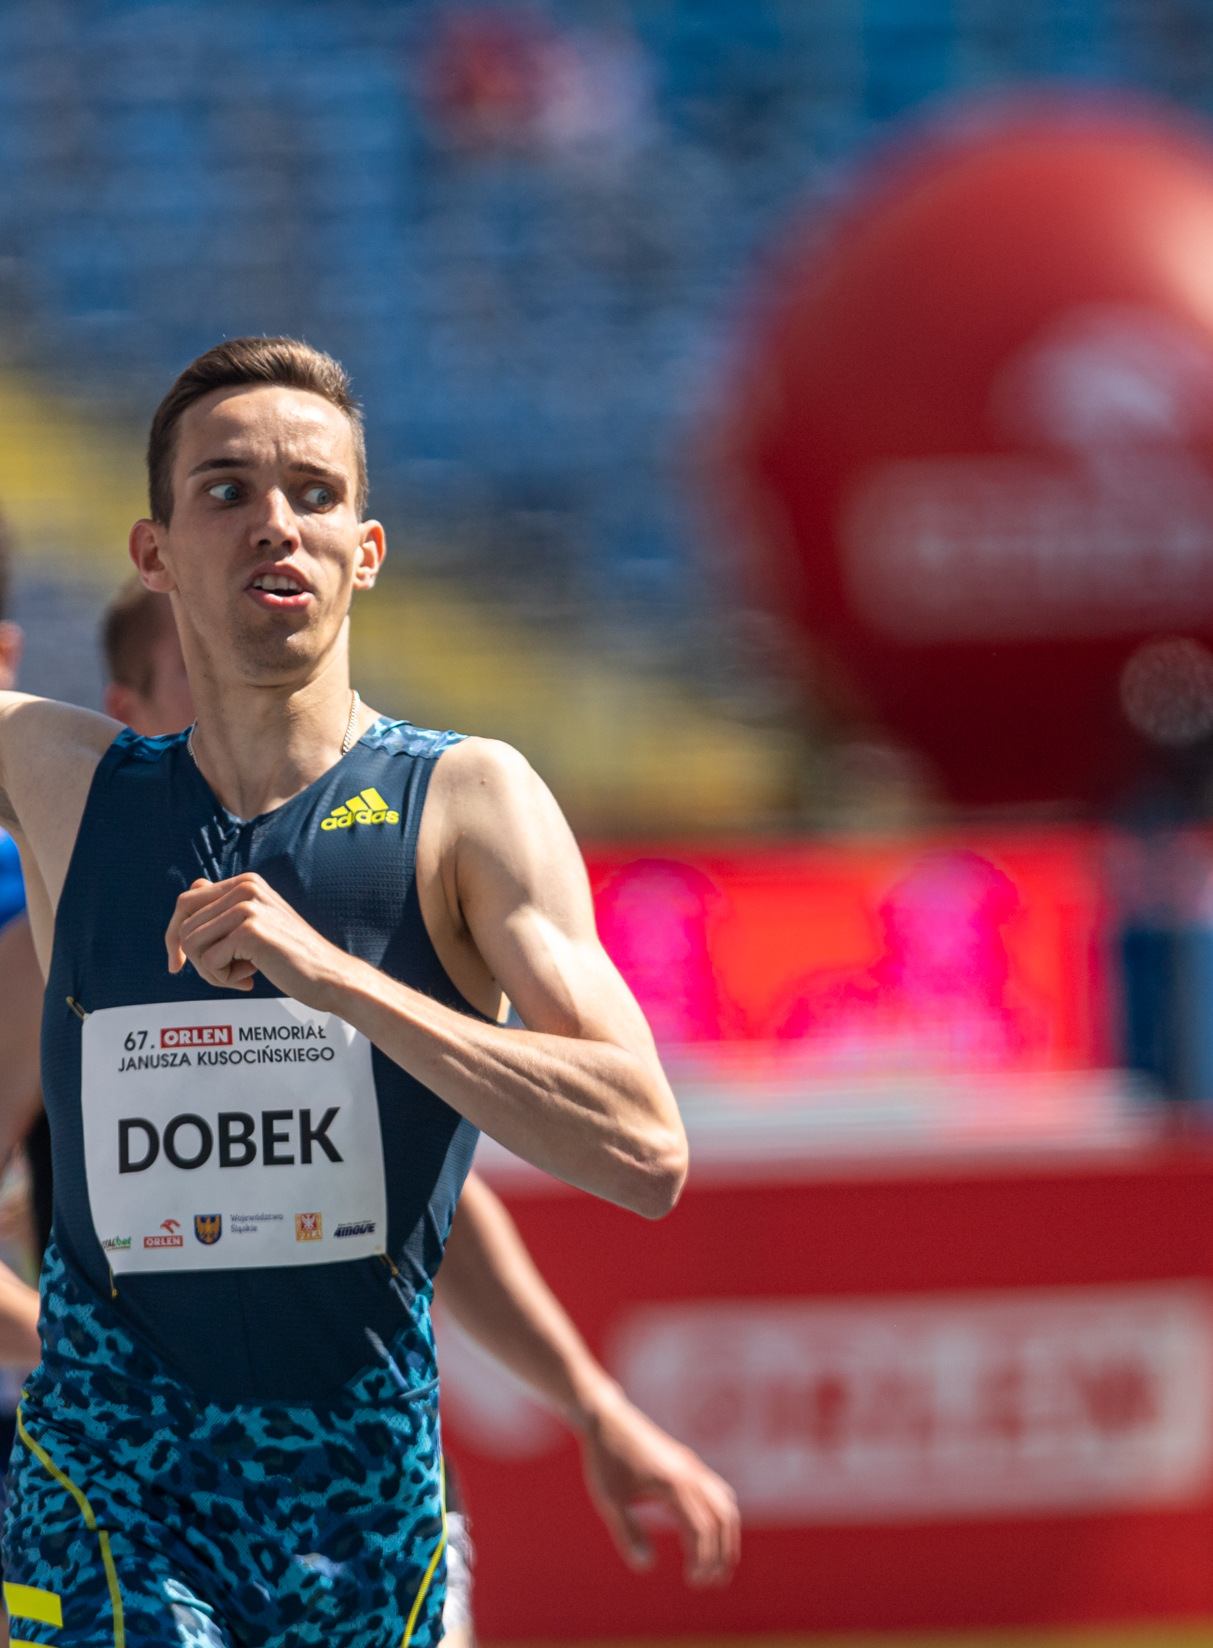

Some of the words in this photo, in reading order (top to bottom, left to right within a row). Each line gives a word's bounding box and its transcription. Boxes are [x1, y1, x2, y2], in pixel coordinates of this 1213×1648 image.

[320, 809, 399, 831] addas
[123, 1030, 155, 1051] 67.
[162, 1027, 230, 1046] ORLEN
[238, 1025, 327, 1042] MEMORIAŁ
[118, 1052, 192, 1072] JANUSZA
[197, 1045, 335, 1066] KUSOCIŃSKIEGO
[118, 1106, 344, 1174] DOBEK
[145, 1236, 182, 1247] ORLEN
